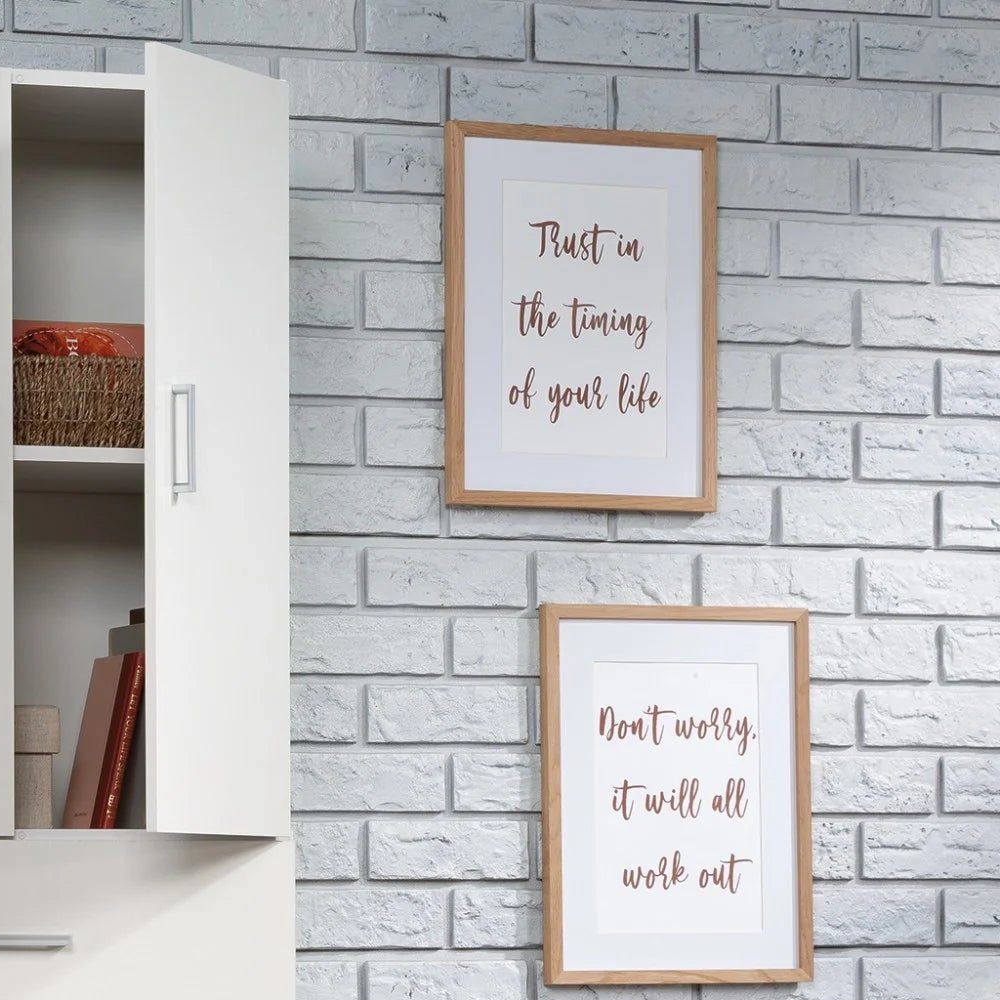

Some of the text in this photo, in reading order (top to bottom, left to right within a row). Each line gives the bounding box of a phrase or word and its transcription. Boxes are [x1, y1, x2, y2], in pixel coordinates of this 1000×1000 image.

[529, 221, 644, 265] Trust in
[511, 291, 652, 349] the timing
[509, 367, 661, 423] of your life
[599, 705, 756, 756] Don't worry,
[612, 778, 748, 820] it will all
[623, 850, 753, 894] work out
